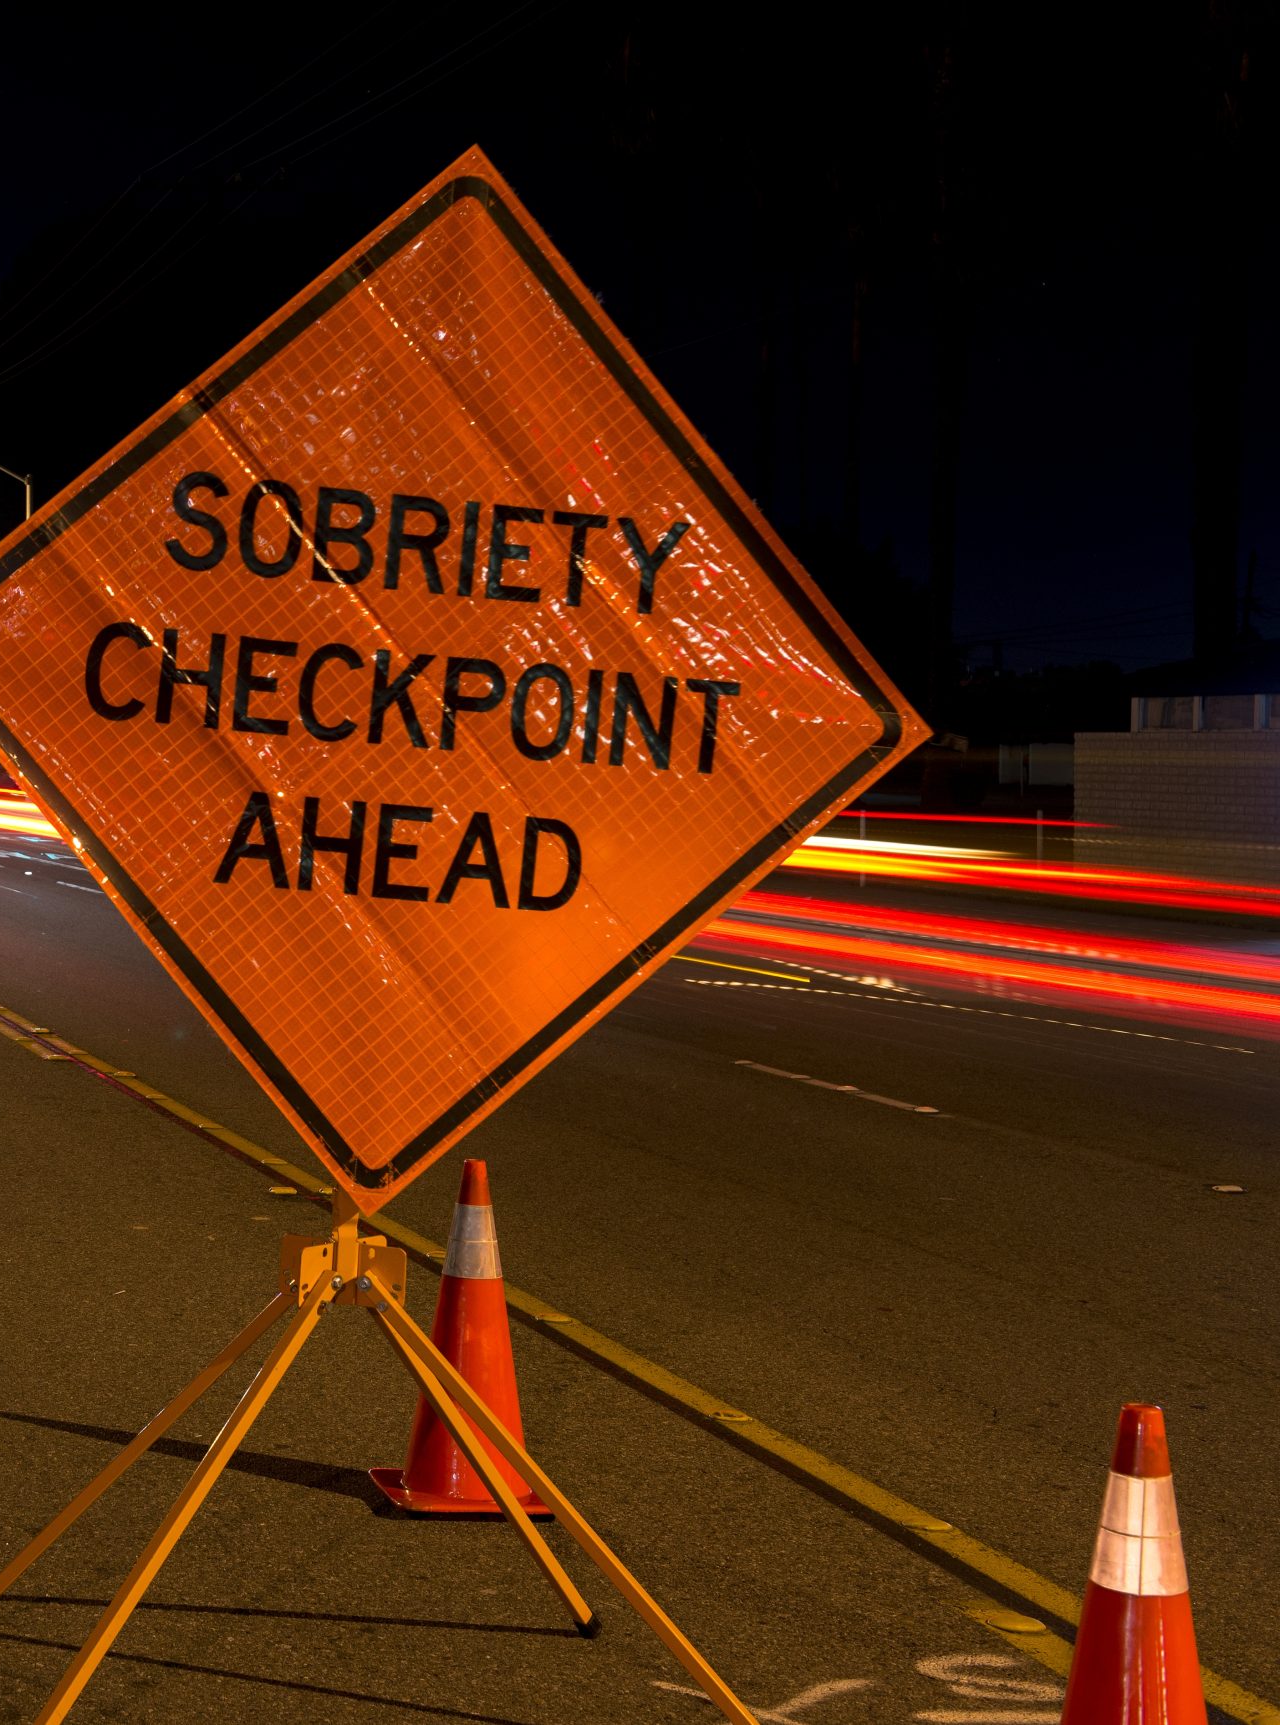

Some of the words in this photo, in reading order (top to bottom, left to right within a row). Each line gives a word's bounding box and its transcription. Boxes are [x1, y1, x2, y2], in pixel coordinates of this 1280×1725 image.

[164, 470, 692, 615] SOBRIETY
[83, 621, 742, 775] CHECKPOINT
[213, 790, 583, 912] AHEAD
